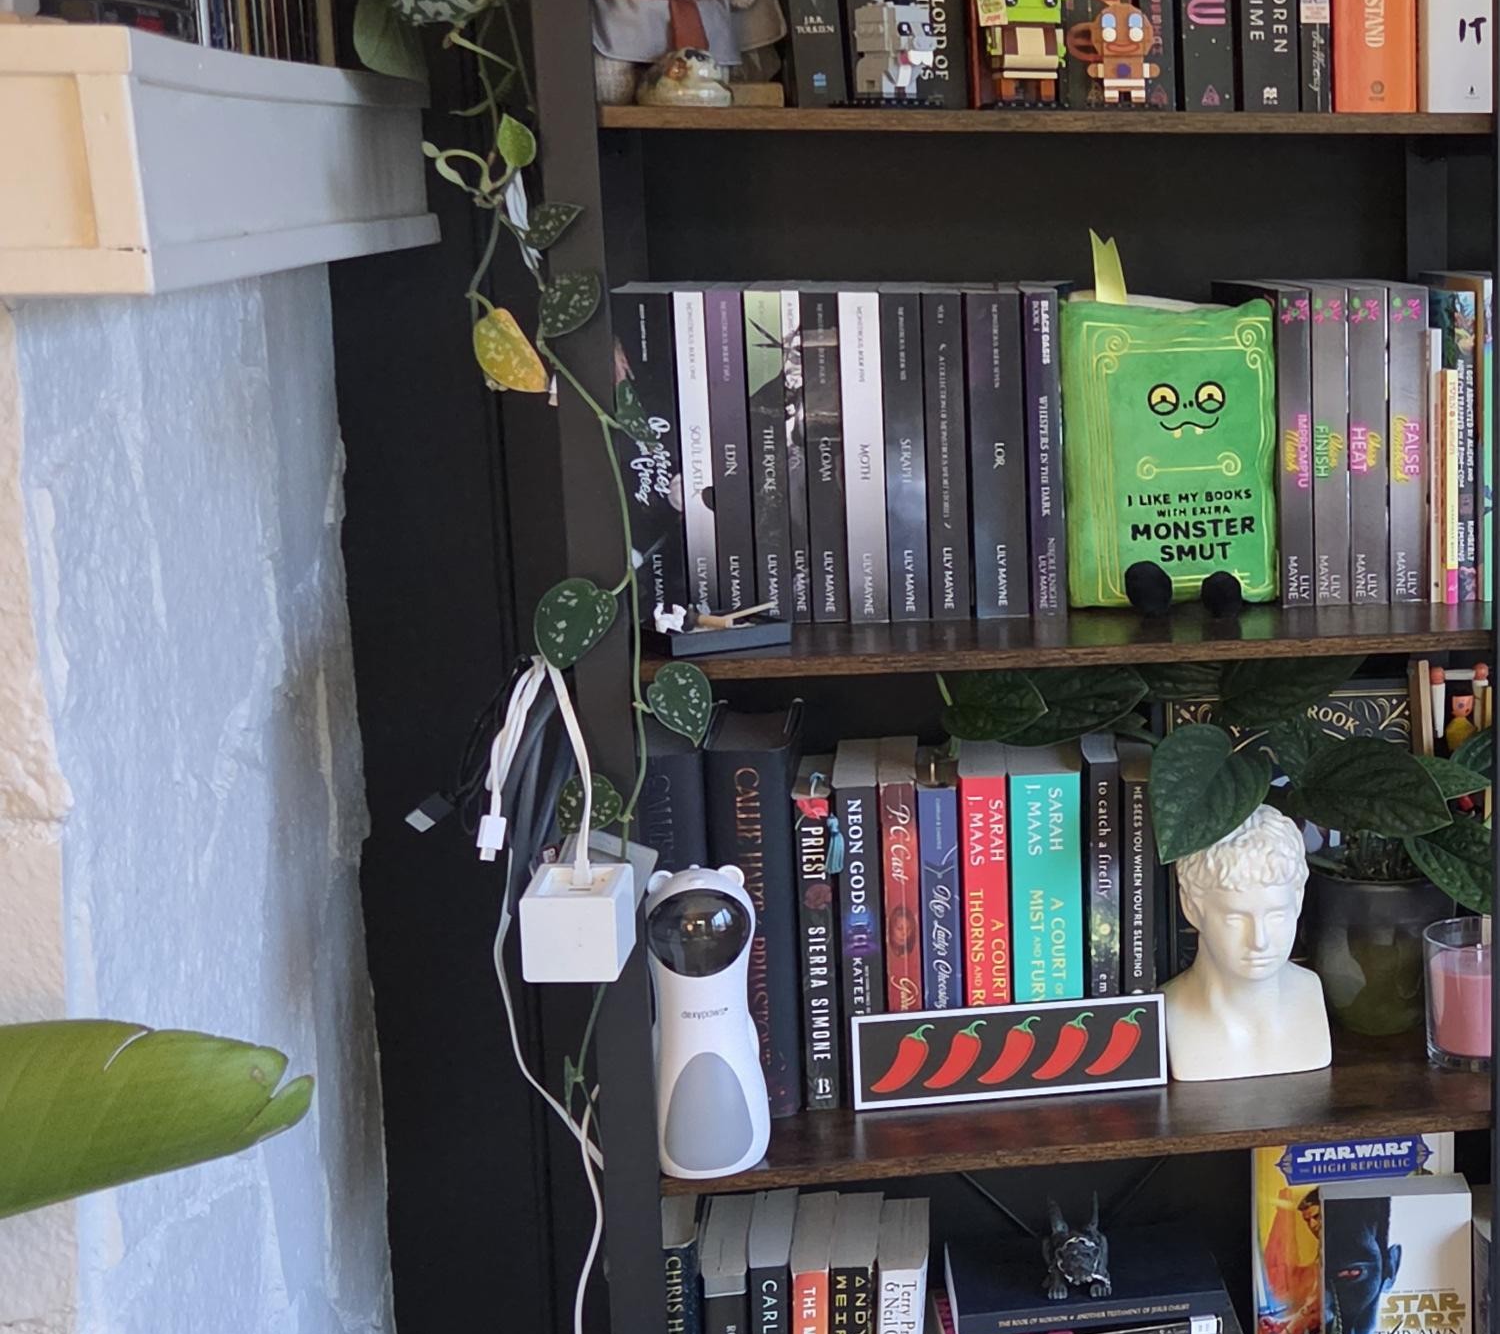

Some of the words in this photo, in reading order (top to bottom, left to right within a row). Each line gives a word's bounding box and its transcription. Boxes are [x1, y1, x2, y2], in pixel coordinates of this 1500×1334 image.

[1459, 16, 1487, 45] IT
[935, 55, 949, 80] OF
[1315, 426, 1329, 478] FINISH
[1351, 428, 1367, 471] HEAT
[1405, 423, 1419, 475] FALSE
[1127, 495, 1132, 507] I
[1139, 493, 1171, 505] LIKE
[1178, 491, 1201, 503] MY
[1205, 488, 1252, 501] BOOKS
[1157, 507, 1187, 517] WITH
[1192, 506, 1231, 516] EXTRA
[1130, 516, 1256, 541] MONSTER
[997, 545, 1007, 571] LILY
[1160, 542, 1232, 563] SMUT
[998, 573, 1008, 607] MAYNE
[846, 798, 864, 853] NEON
[969, 813, 985, 867] MAAS
[988, 798, 1005, 862] SARAH
[801, 826, 826, 881] PRIEST
[849, 861, 866, 915] GODS
[968, 889, 985, 965] THORNS
[807, 926, 827, 989] SIERRA
[810, 998, 831, 1061] SIMONE
[1297, 1146, 1354, 1164] STAR
[1354, 1141, 1412, 1159] WARS
[1312, 1162, 1347, 1175] HIGH
[1349, 1157, 1411, 1173] REPUBLIC
[762, 1280, 778, 1334] CARL
[802, 1287, 817, 1318] THE
